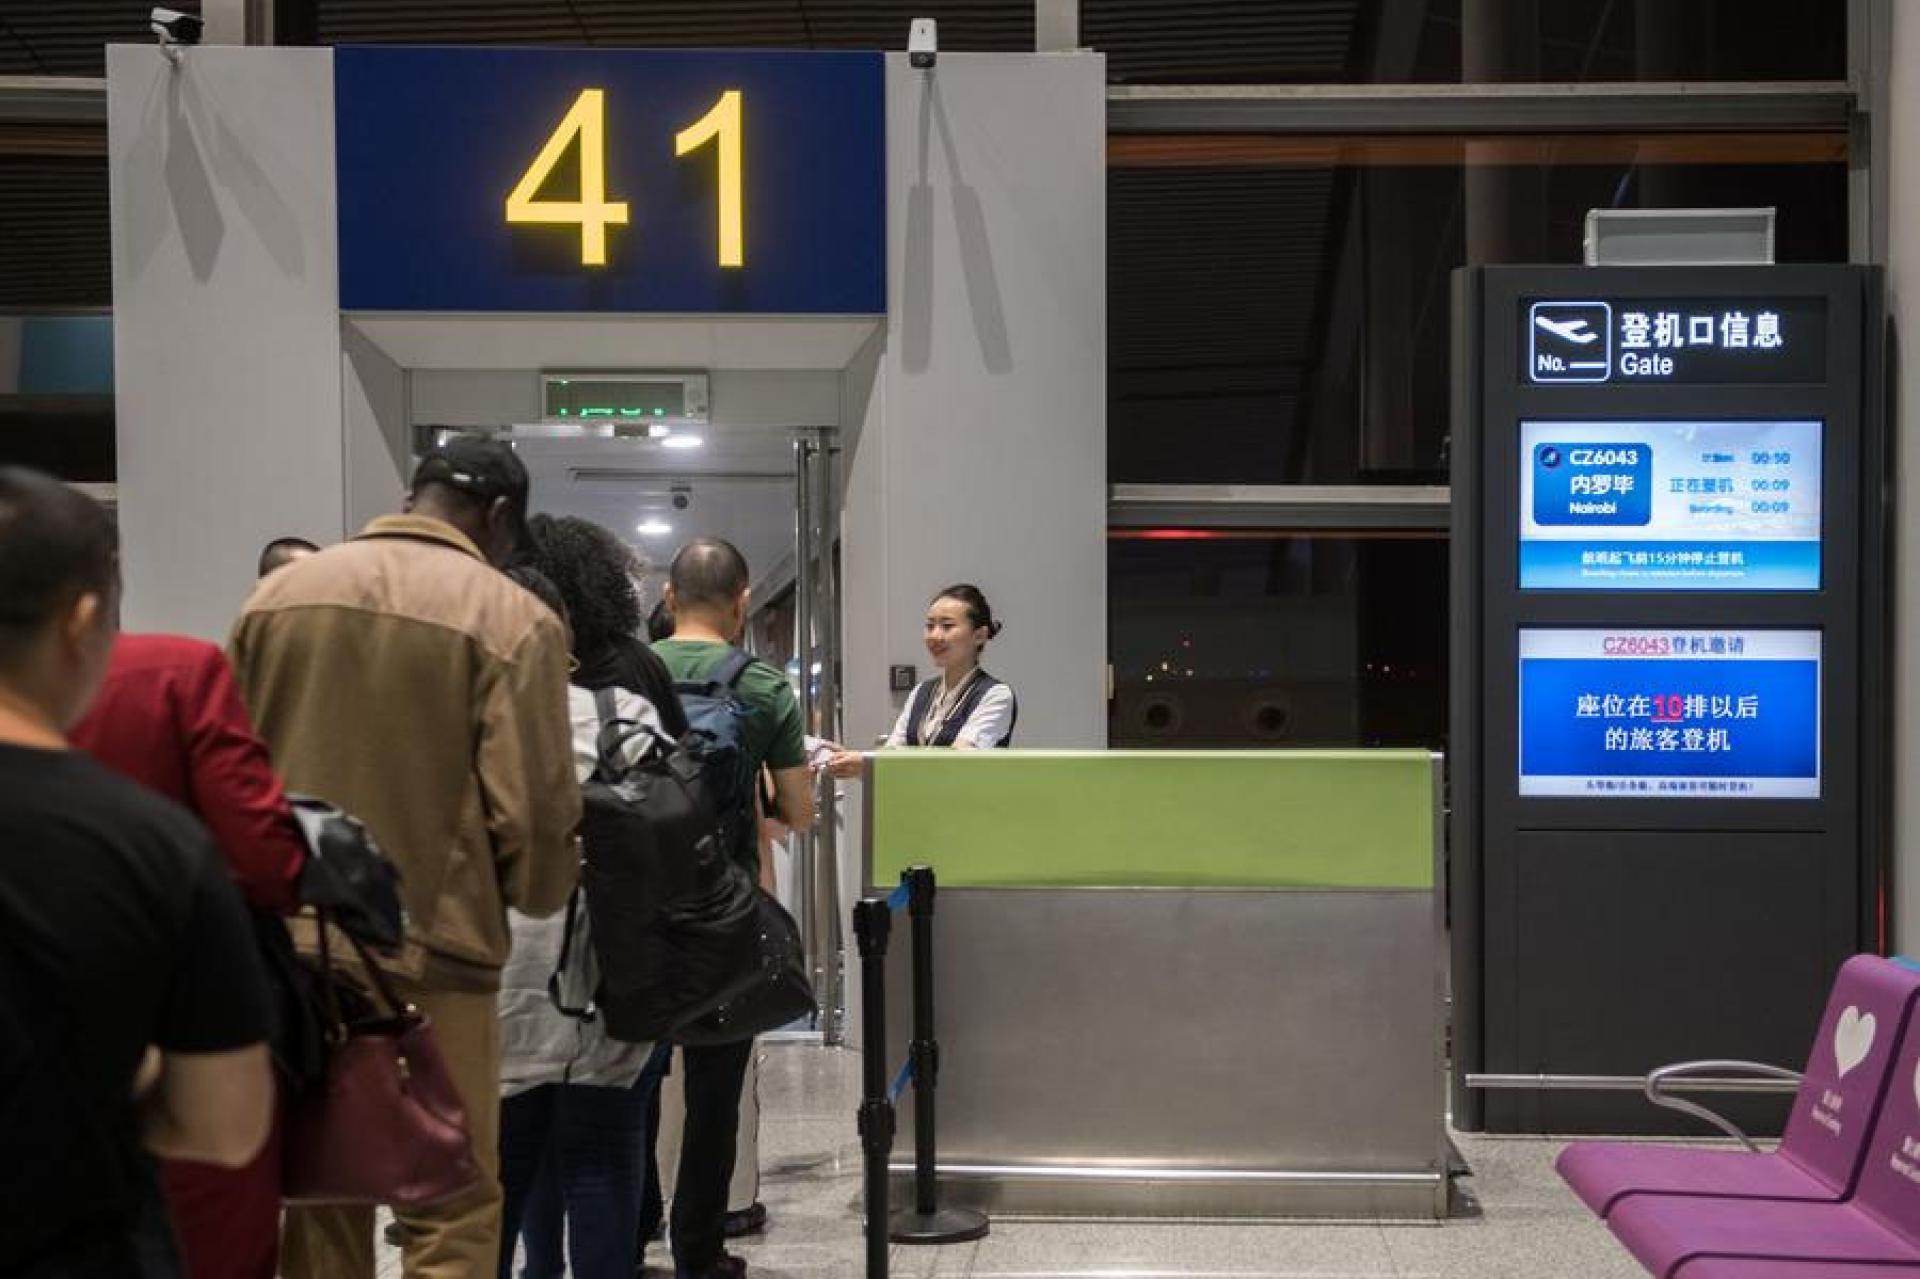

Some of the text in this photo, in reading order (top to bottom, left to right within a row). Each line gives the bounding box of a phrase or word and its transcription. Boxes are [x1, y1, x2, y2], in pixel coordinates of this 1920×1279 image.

[505, 88, 744, 267] 41
[1620, 312, 1783, 348] 登机口信息
[1537, 354, 1566, 371] No.
[1620, 353, 1674, 375] Gate
[1569, 449, 1639, 465] CZ6043
[1571, 474, 1634, 495] 内罗毕
[1569, 502, 1617, 515] Nairobi
[1576, 694, 1759, 721] 座位在10排以后
[1605, 726, 1731, 752] 的旅客登机
